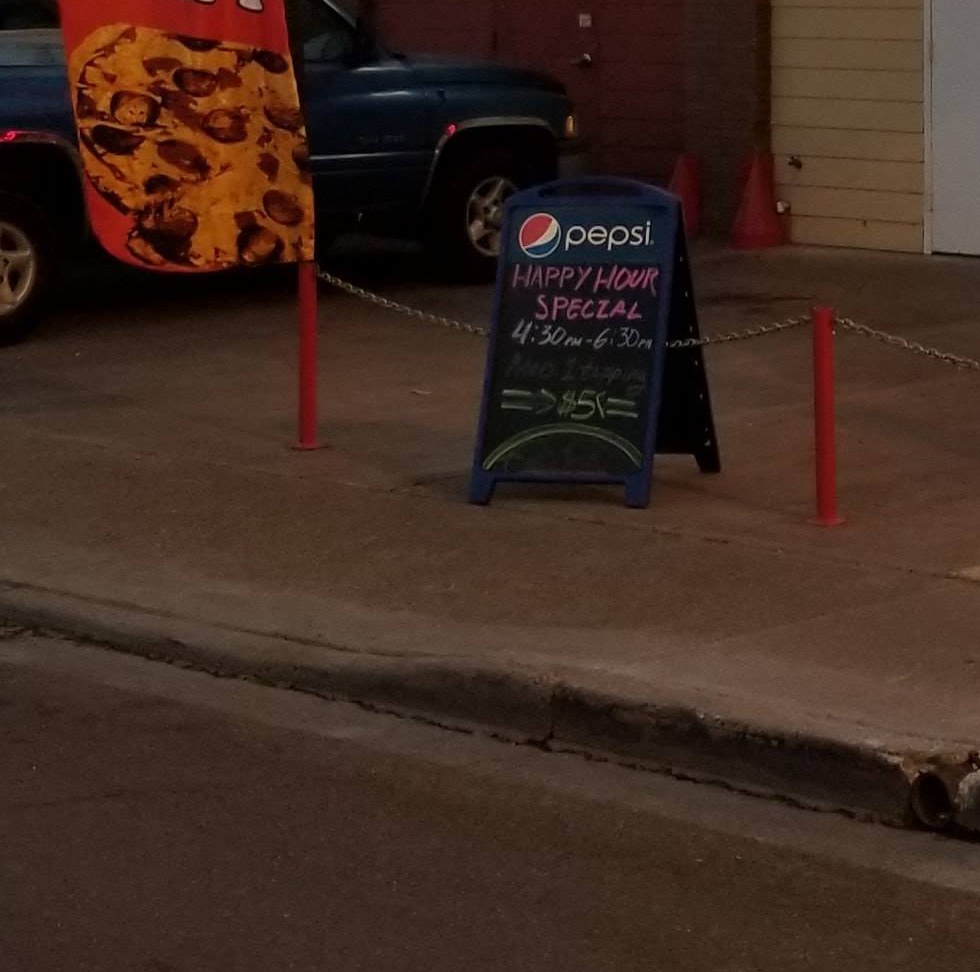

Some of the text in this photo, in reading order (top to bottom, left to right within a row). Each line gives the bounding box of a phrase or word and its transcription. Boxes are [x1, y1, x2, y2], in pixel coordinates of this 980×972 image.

[565, 220, 654, 252] pepsi
[511, 263, 660, 297] HAPPY HOUR
